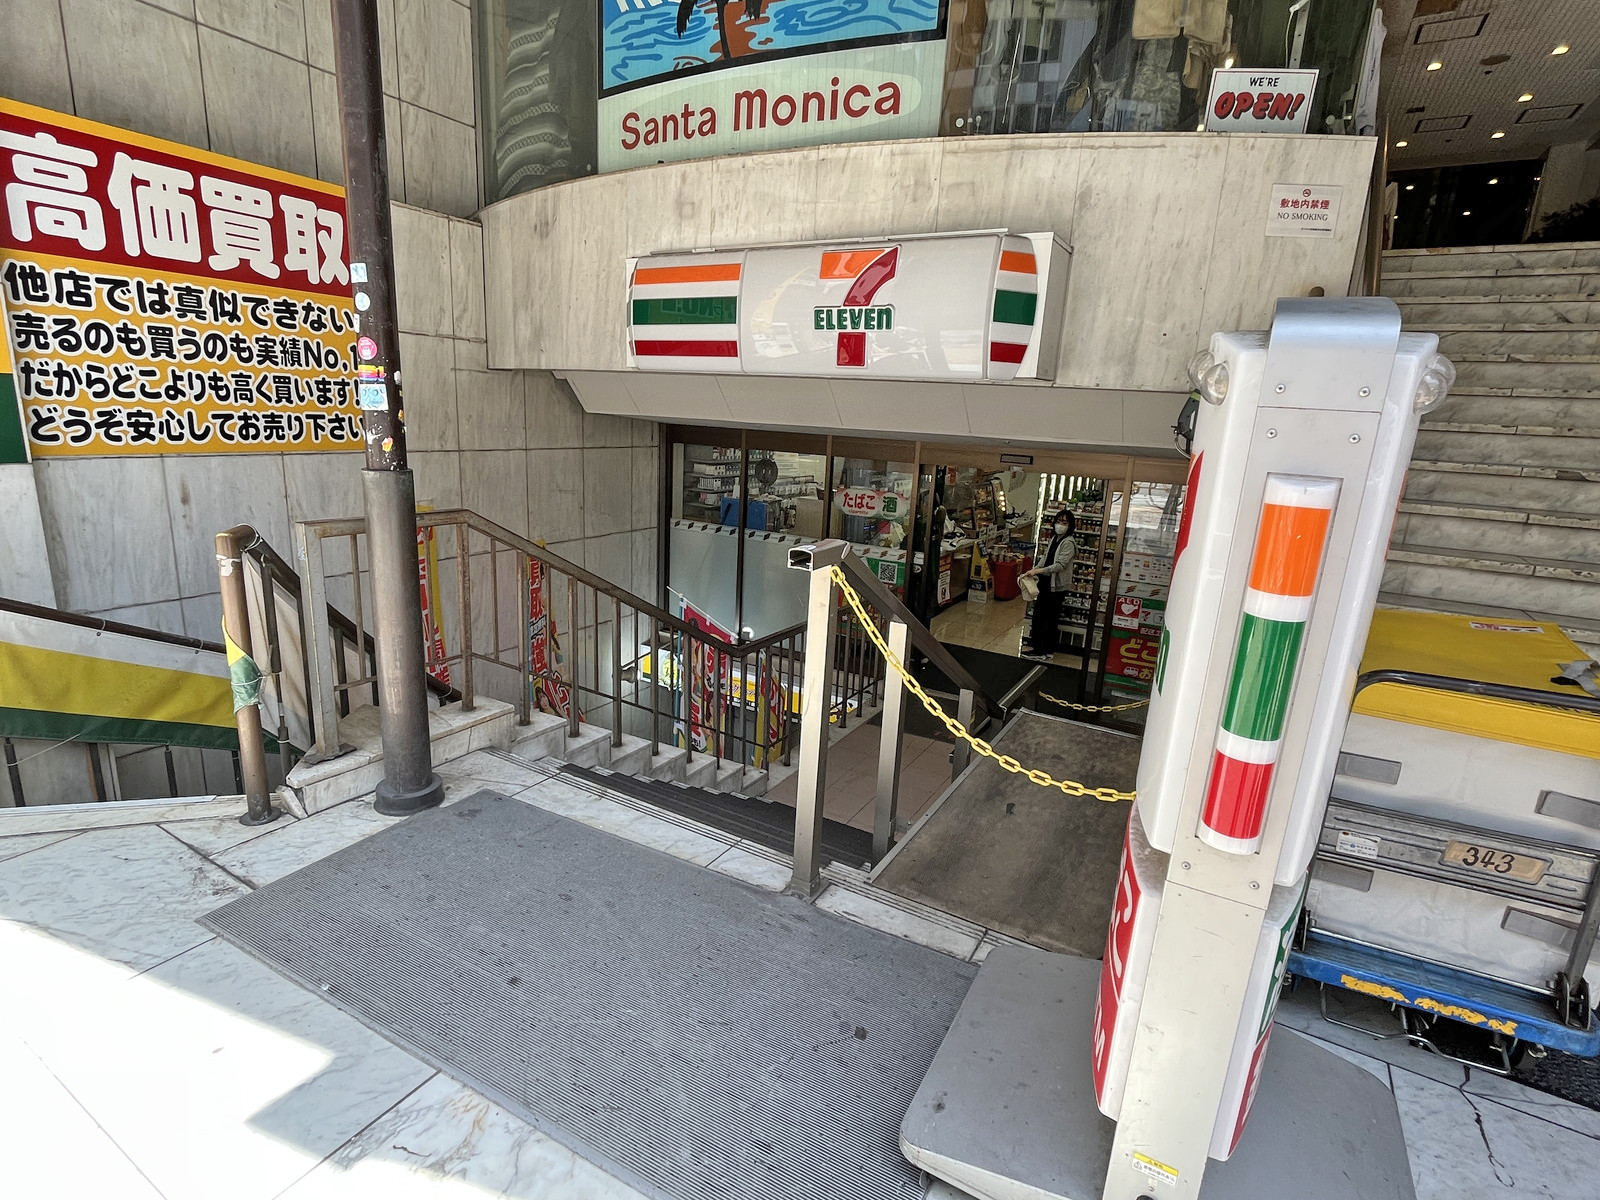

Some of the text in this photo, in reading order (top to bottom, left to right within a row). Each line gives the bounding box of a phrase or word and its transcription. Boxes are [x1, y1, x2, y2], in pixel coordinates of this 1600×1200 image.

[1249, 76, 1280, 87] WE'RE
[1214, 91, 1306, 120] OPEN!
[620, 103, 717, 150] Santa
[0, 131, 349, 286] 高価買取
[1280, 197, 1330, 210] 敷地内禁煙
[1277, 212, 1328, 221] NO SMOKING
[843, 491, 898, 513] たばこ 酒
[1462, 846, 1515, 874] 343
